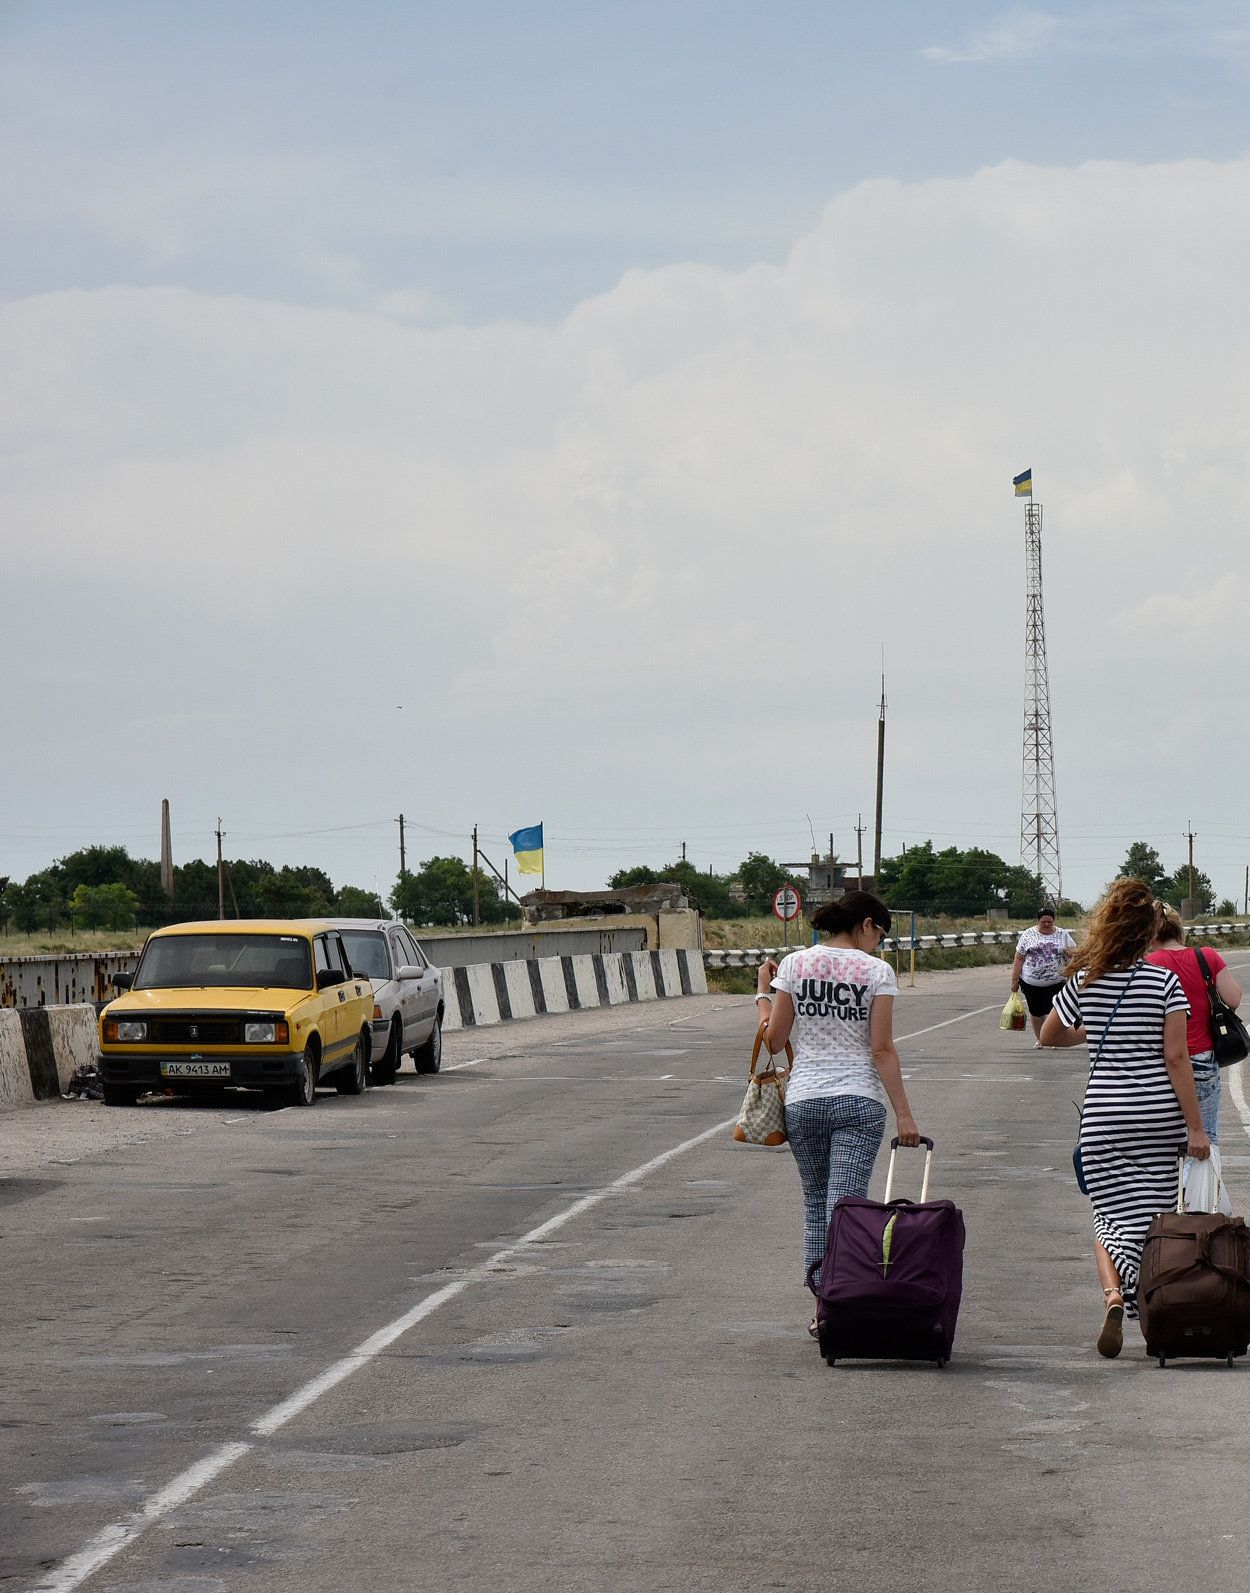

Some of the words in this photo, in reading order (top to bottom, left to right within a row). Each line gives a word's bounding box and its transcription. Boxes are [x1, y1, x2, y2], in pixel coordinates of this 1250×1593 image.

[796, 955, 870, 984] LOVE
[796, 978, 868, 1007] JUICY
[797, 1002, 868, 1021] COUTURE
[168, 1064, 182, 1074] AK
[185, 1065, 209, 1075] 9413
